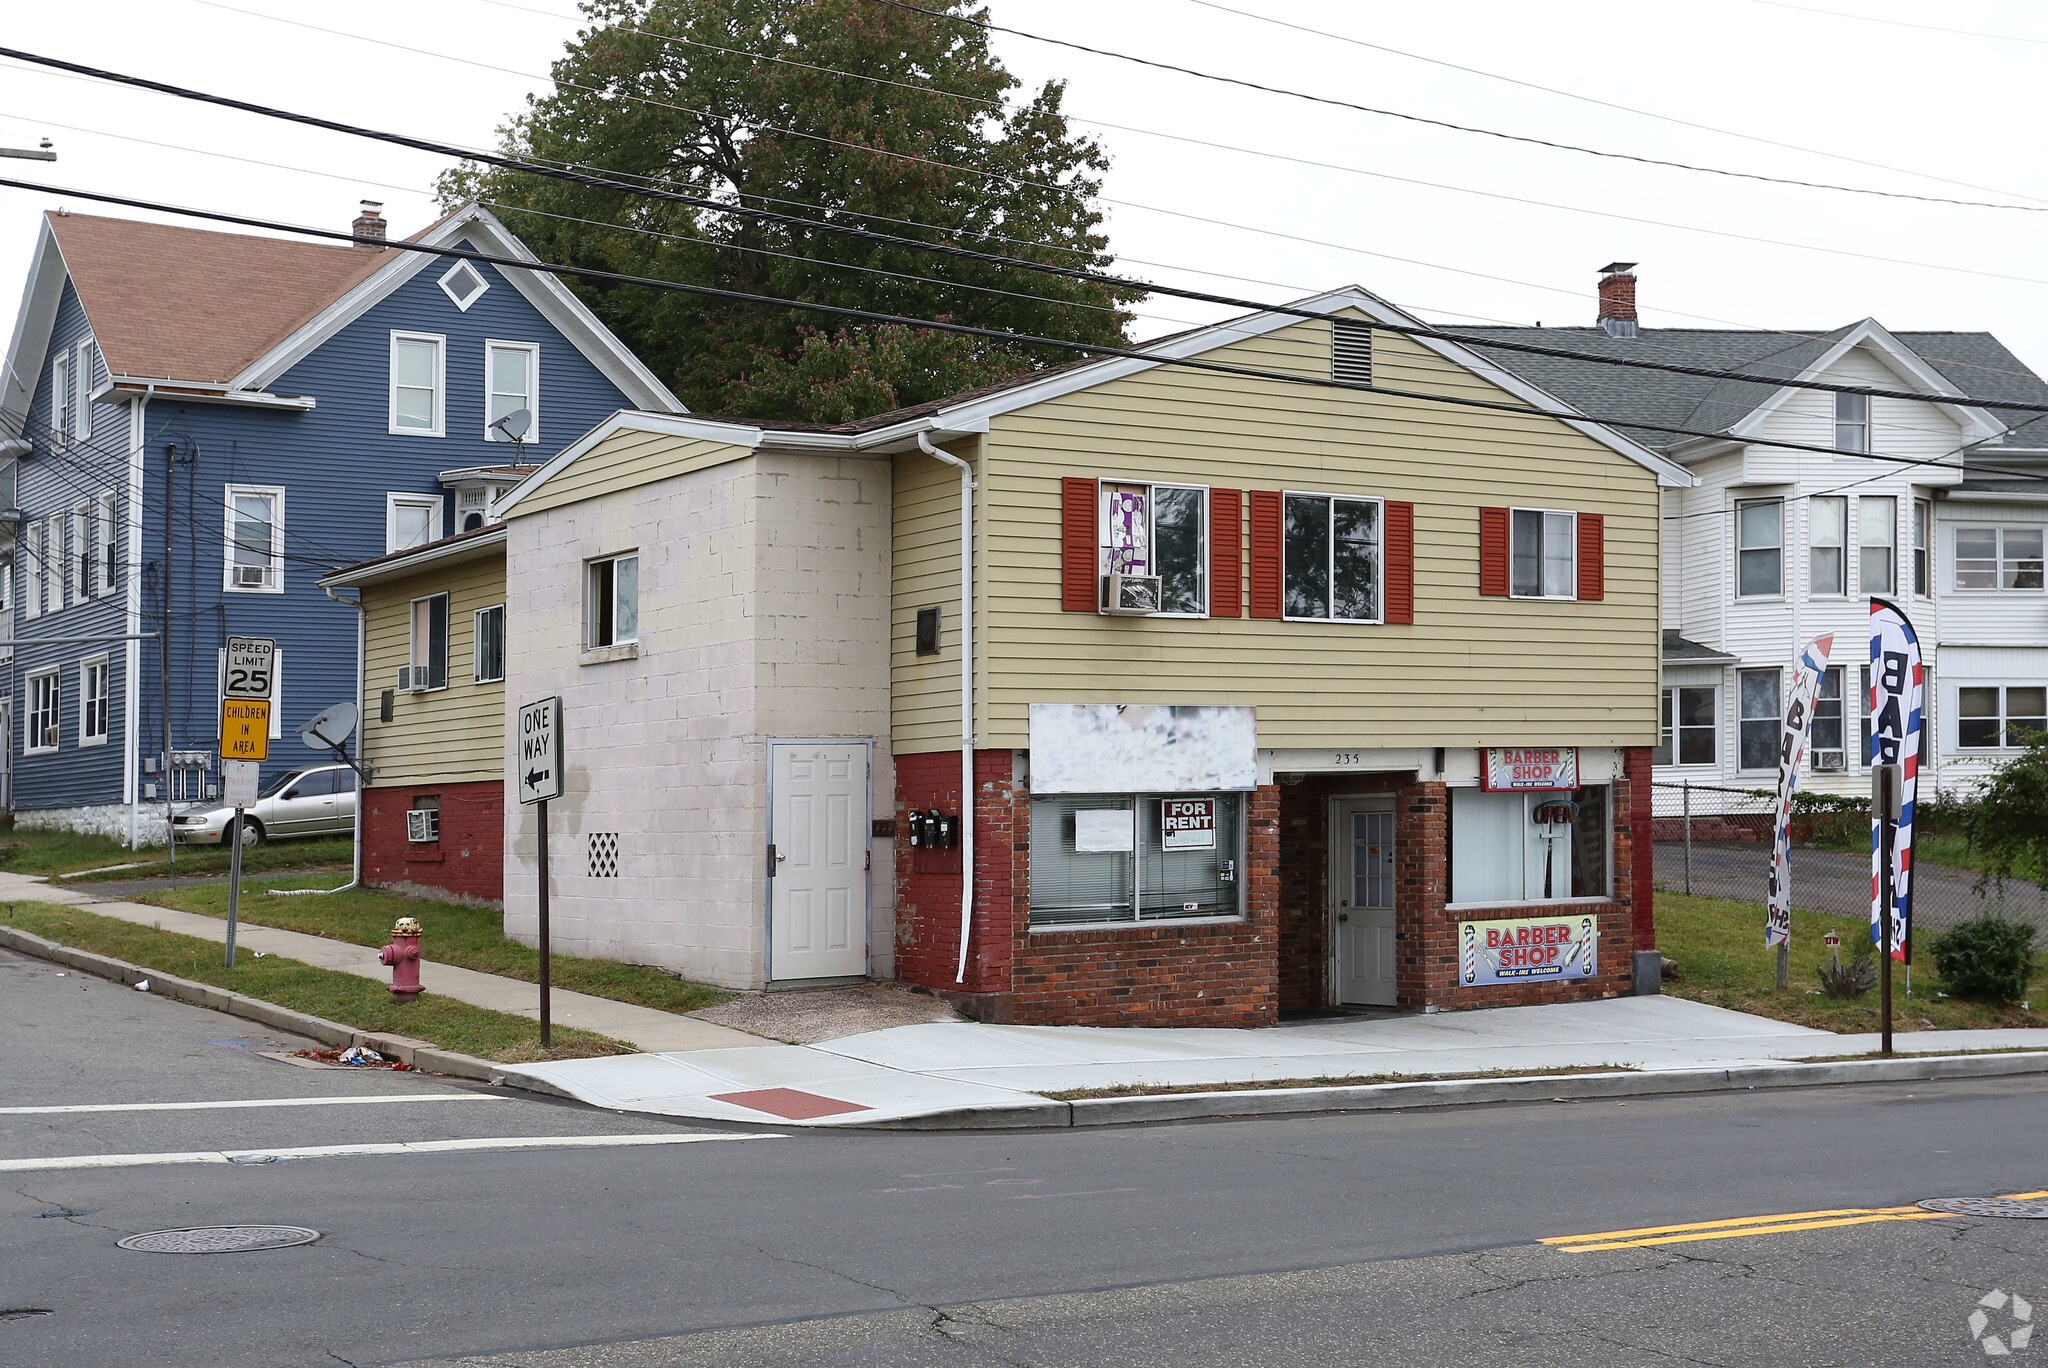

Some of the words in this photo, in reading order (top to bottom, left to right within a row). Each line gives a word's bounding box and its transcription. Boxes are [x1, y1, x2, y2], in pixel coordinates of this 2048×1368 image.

[231, 643, 271, 654] SPEED
[234, 656, 265, 667] LIMIT
[228, 669, 268, 692] 25
[226, 706, 267, 719] CHILDREN
[524, 706, 550, 735] ONE
[241, 724, 250, 736] IN
[233, 741, 255, 753] AREA
[523, 732, 550, 761] WAY
[1335, 753, 1359, 765] 235
[1504, 750, 1560, 764] BARBER
[236, 766, 249, 775] NO
[1512, 765, 1553, 780] SHOP
[227, 777, 257, 787] PARKING
[1171, 802, 1206, 816] FOR
[1535, 805, 1577, 824] OPEN
[1166, 815, 1212, 829] RENT
[1486, 924, 1571, 949] BARBER
[1499, 945, 1559, 968] SHOP
[1499, 969, 1529, 977] WALK-INS
[1531, 966, 1560, 975] WELCOME
